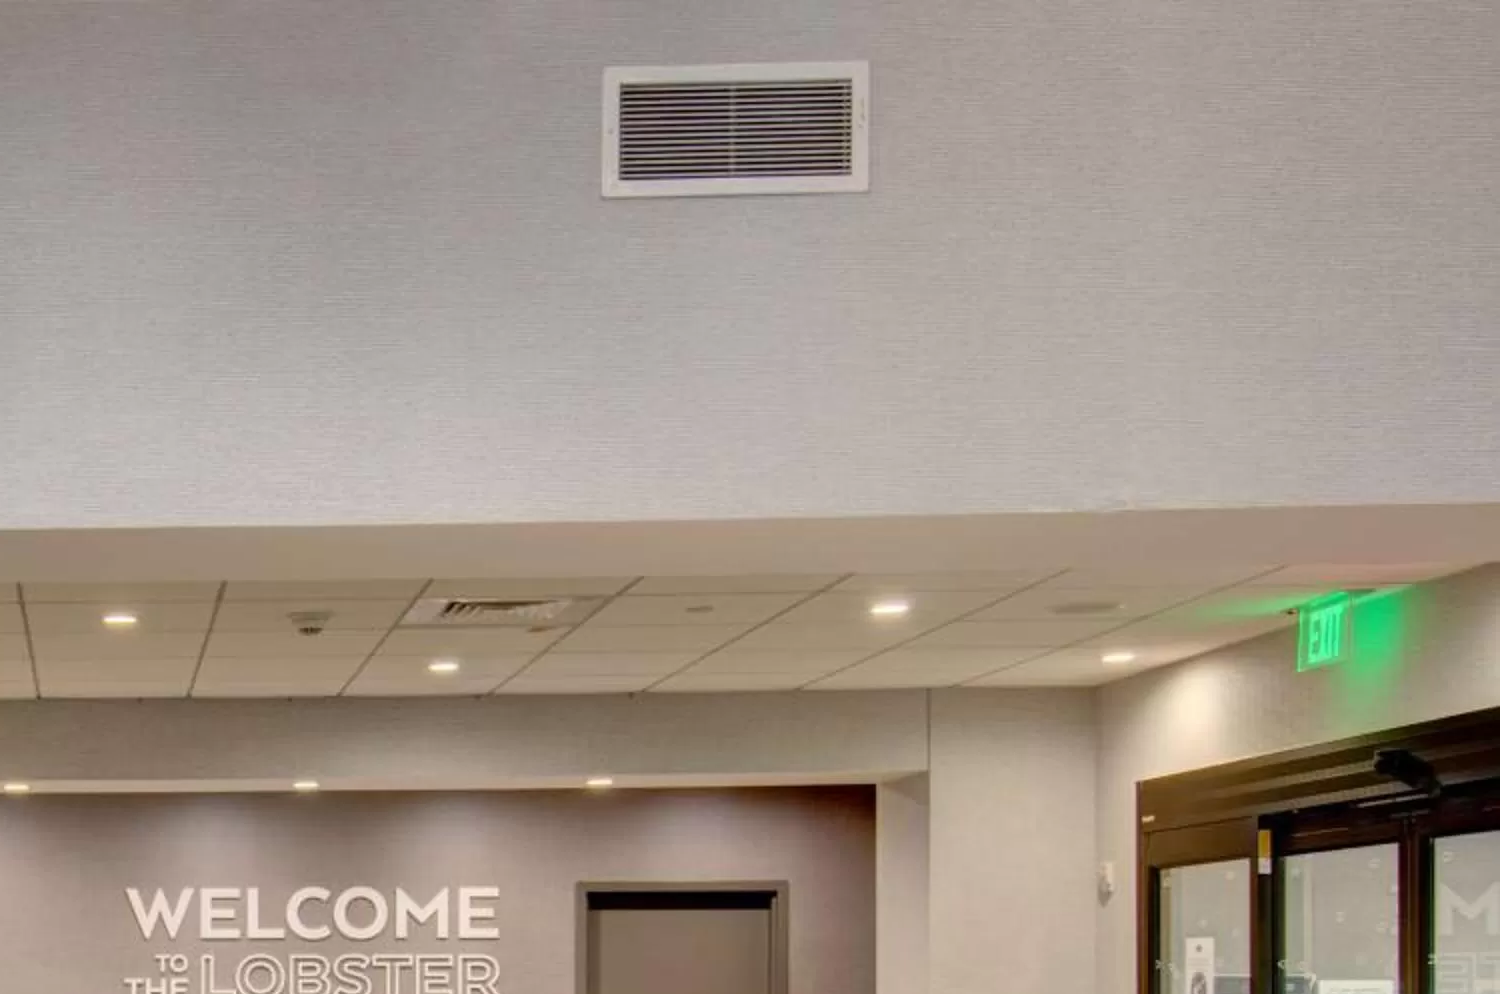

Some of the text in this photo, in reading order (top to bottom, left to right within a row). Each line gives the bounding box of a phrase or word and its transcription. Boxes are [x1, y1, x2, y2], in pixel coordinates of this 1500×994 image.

[1308, 604, 1343, 664] EXIT
[125, 886, 501, 940] WELCOME
[155, 953, 188, 974] TO
